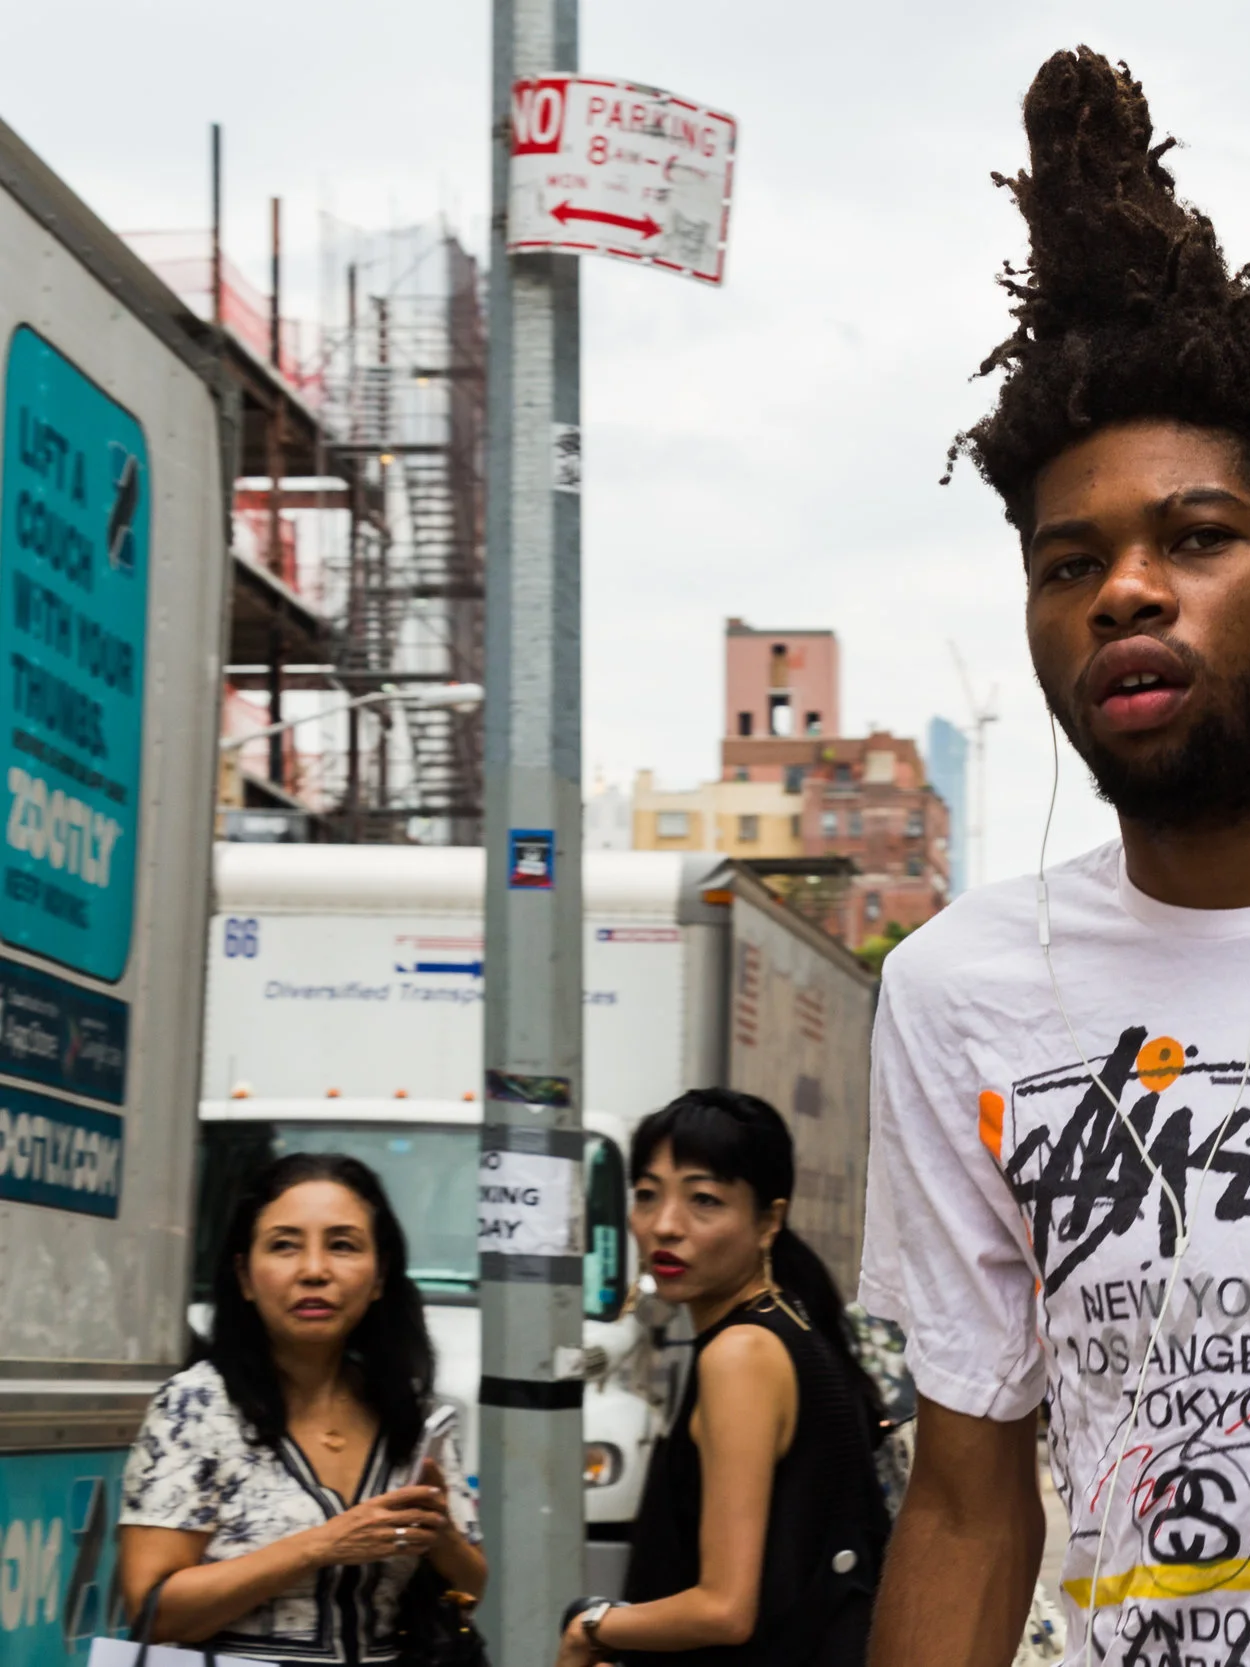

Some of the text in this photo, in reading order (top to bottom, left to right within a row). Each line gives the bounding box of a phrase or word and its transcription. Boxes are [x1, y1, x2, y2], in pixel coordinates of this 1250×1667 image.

[586, 96, 716, 158] PARKING
[1079, 1279, 1166, 1323] NEW
[1067, 1335, 1131, 1376] LOS
